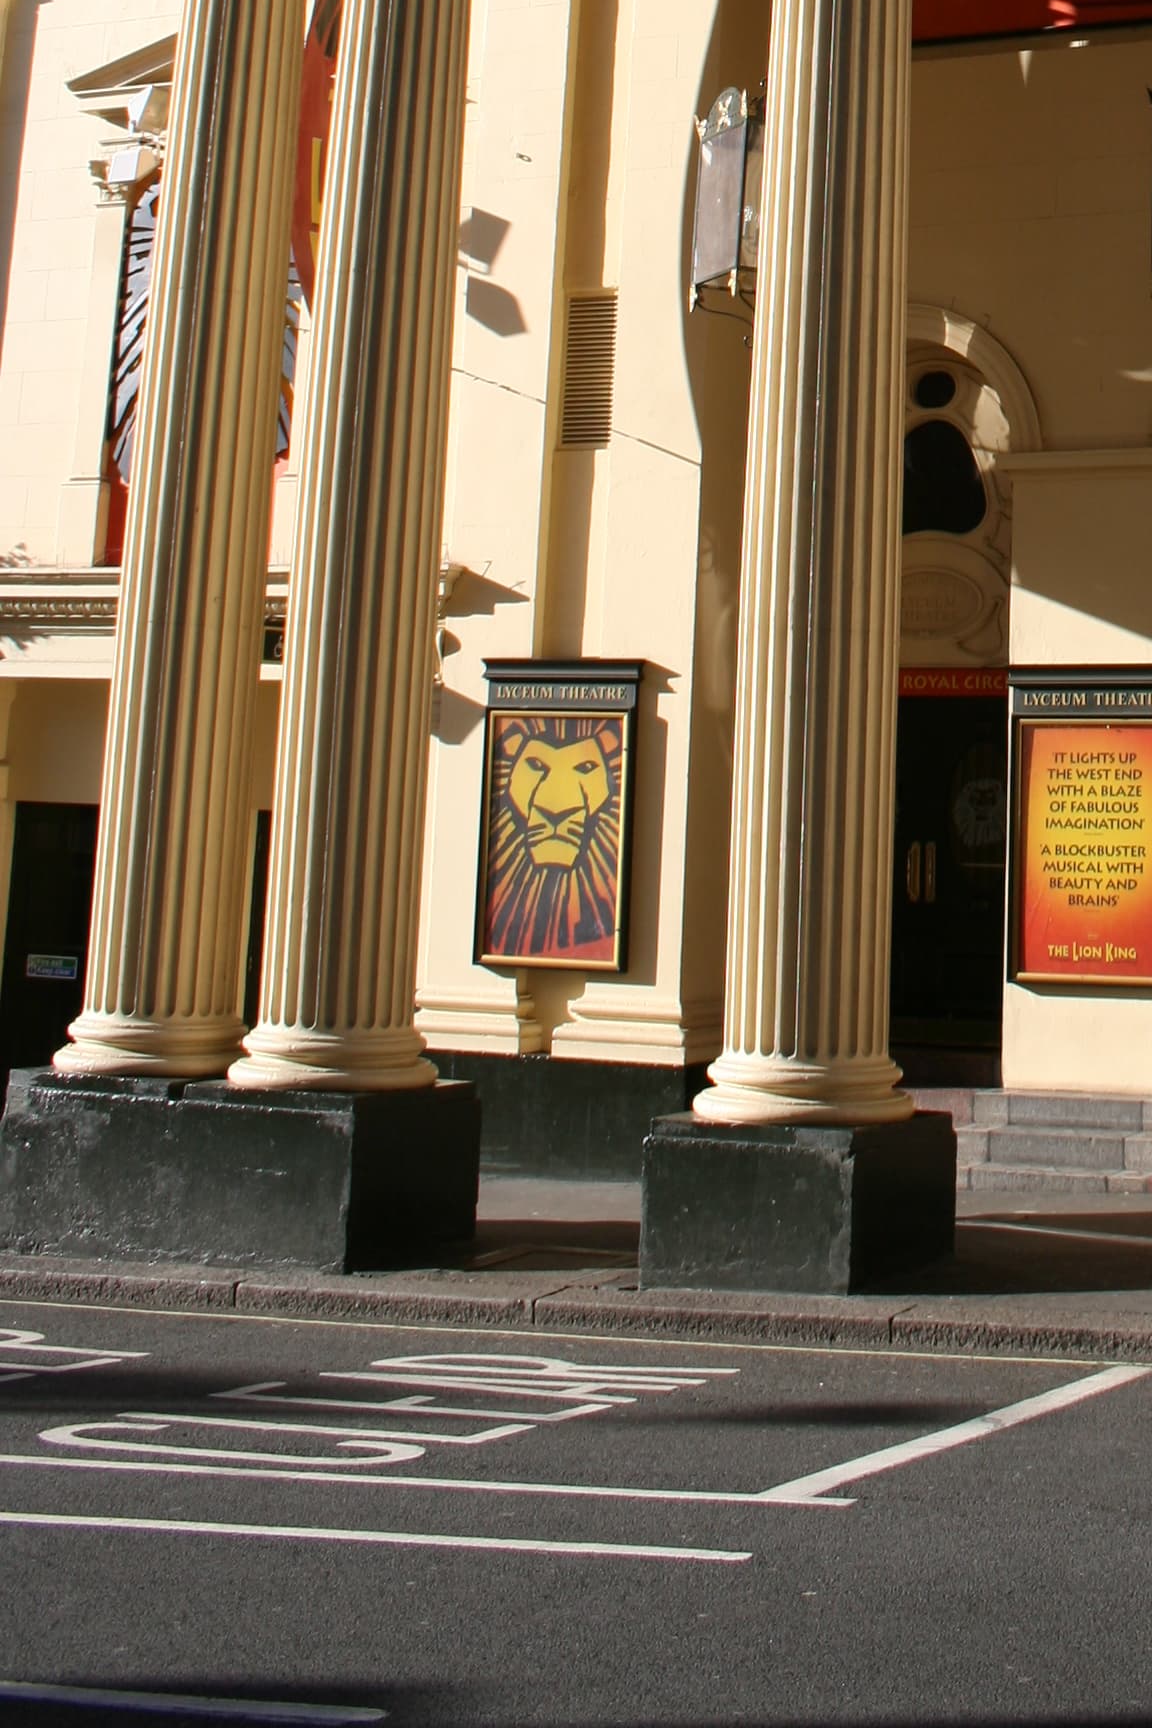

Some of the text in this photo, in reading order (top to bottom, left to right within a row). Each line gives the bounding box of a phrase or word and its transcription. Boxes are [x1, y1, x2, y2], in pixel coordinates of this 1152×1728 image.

[903, 673, 1008, 689] ROYAL CIRC
[496, 685, 627, 700] LYCEUM THEATRE
[1023, 692, 1088, 707] LYCEUM
[1070, 751, 1115, 764] LIGHTS
[1119, 752, 1137, 765] UP
[1047, 767, 1143, 781] THE WEST END
[1046, 784, 1143, 797] WITH A BLAZE
[1049, 801, 1139, 814] OF FABULOUS
[1055, 844, 1147, 858] BLOCKBUSTER
[1042, 861, 1144, 874] MUSICAL WITH
[1049, 877, 1138, 891] BEAUTY AND
[1047, 941, 1138, 963] THE LION KING
[38, 1354, 741, 1465] CLEAR
